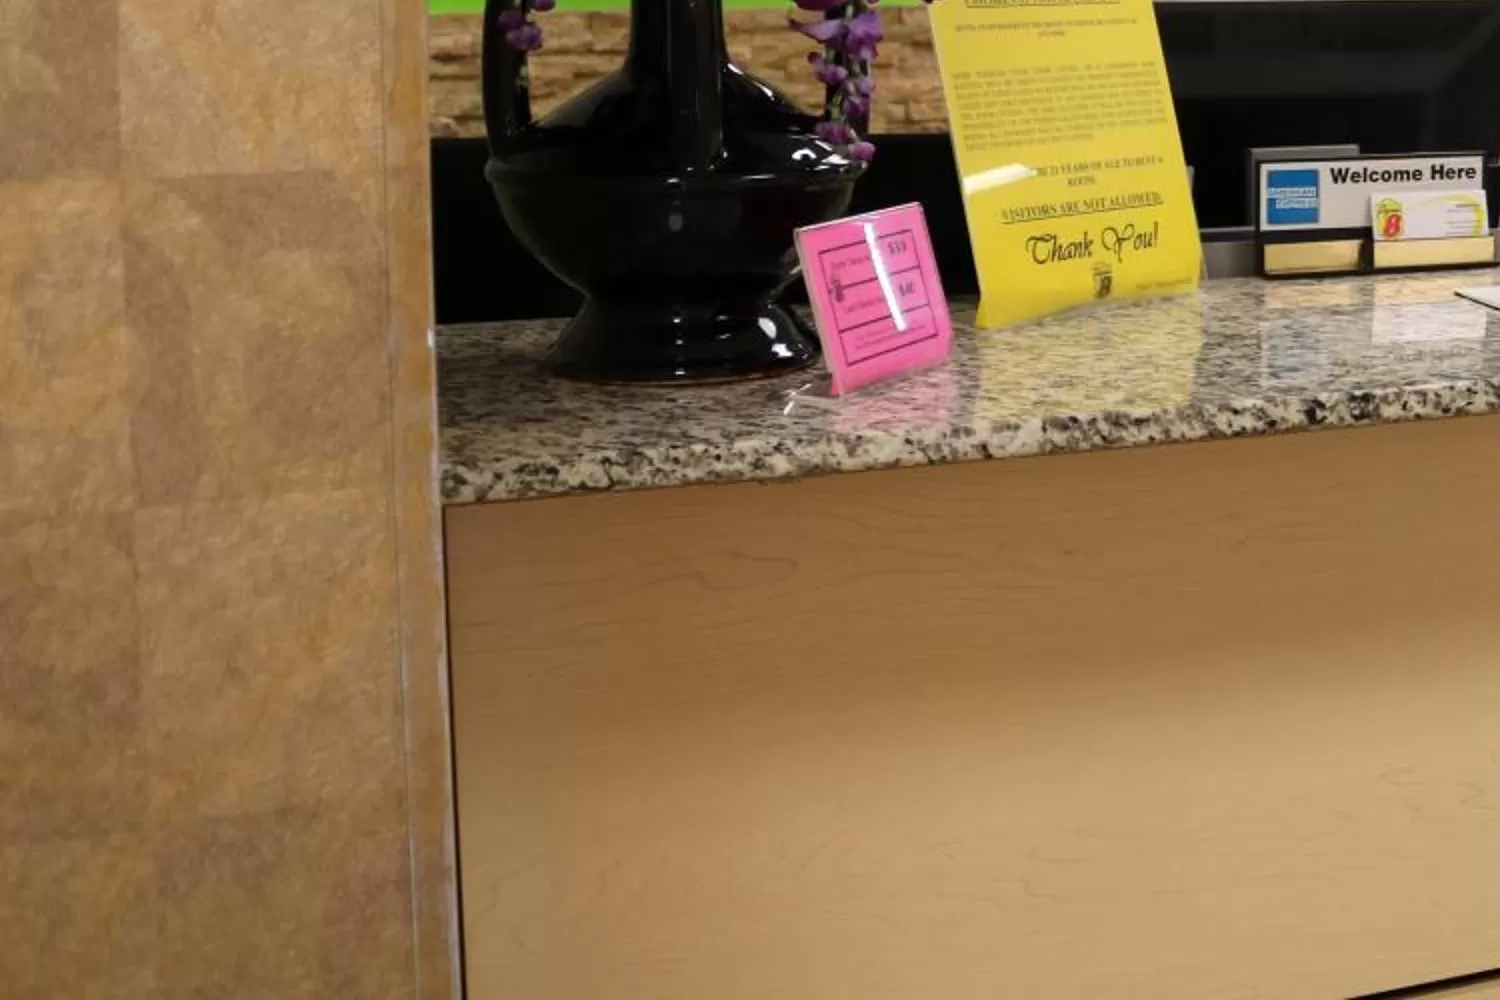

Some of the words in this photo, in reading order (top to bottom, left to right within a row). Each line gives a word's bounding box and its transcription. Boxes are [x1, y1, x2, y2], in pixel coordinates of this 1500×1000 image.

[1329, 166, 1423, 185] Welcome
[1429, 163, 1477, 182] Here
[1001, 203, 1057, 221] VISITORS
[1059, 200, 1079, 214] ARE
[1082, 197, 1105, 211] NOT
[1025, 230, 1093, 265] Thank
[1101, 220, 1159, 264] You!
